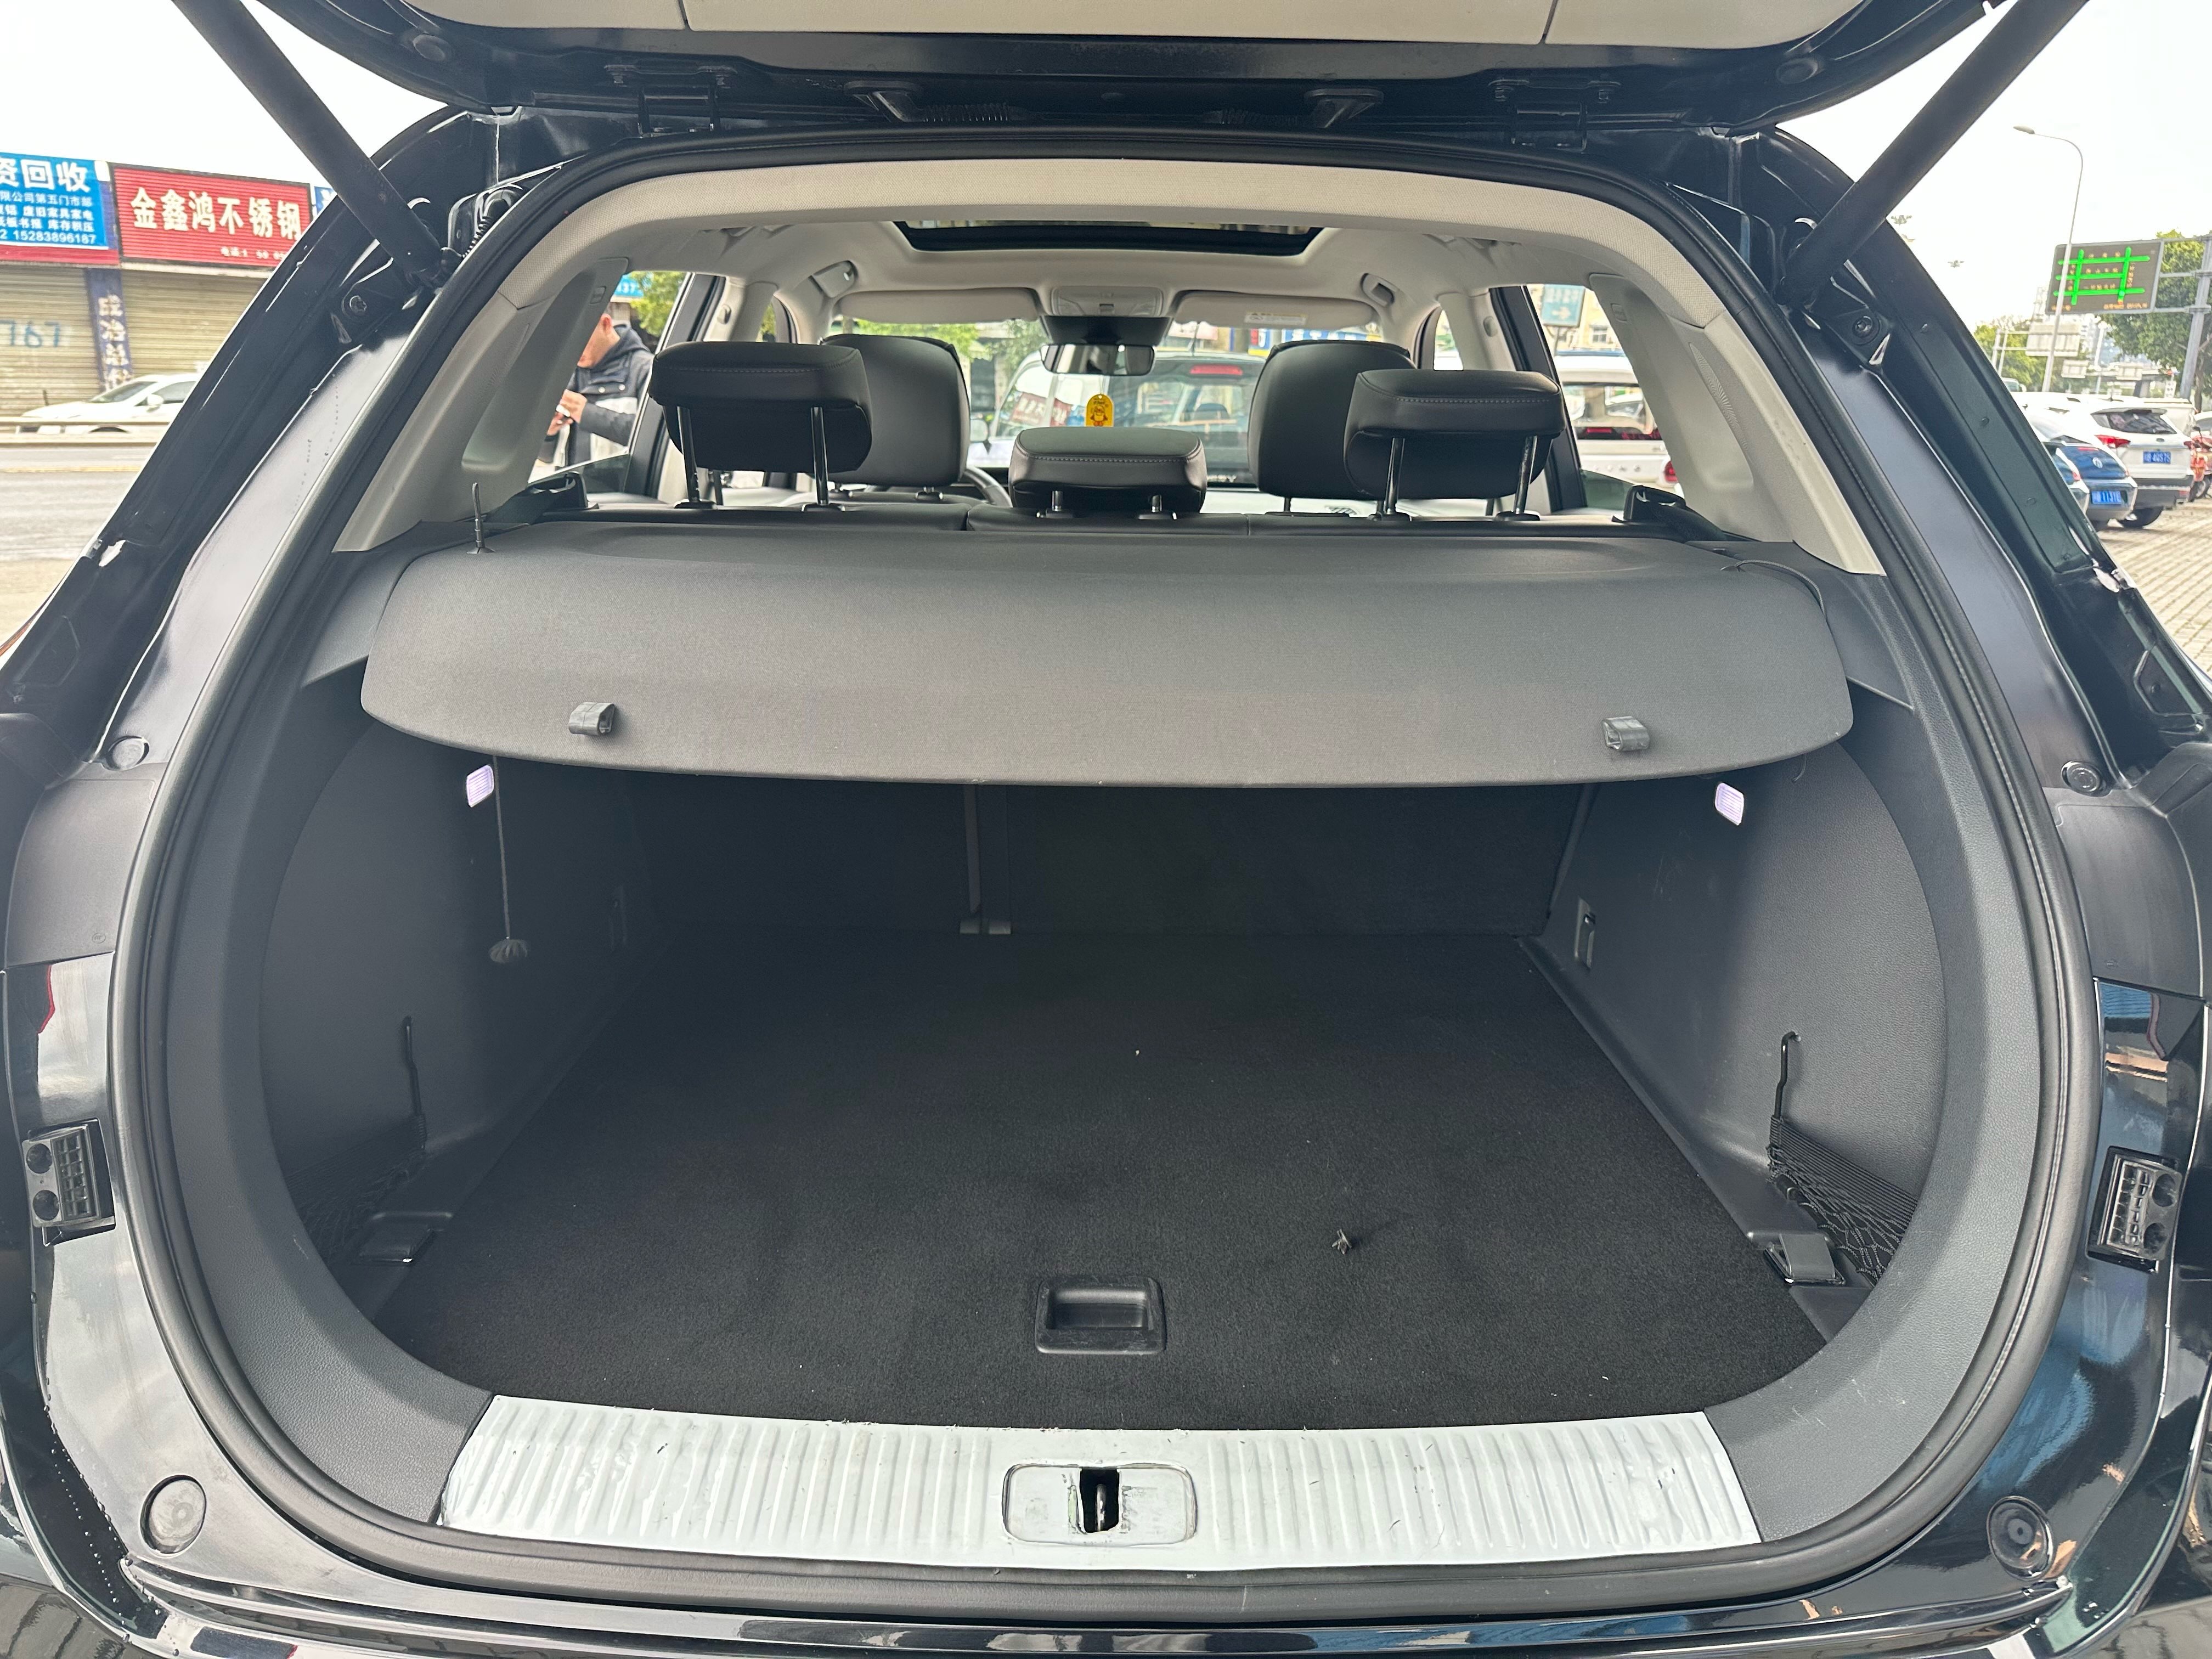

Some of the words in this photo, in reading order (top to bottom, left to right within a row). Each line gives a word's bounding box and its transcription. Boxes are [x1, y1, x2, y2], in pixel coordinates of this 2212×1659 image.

[130, 187, 302, 240] 金鑫鸿不锈钢
